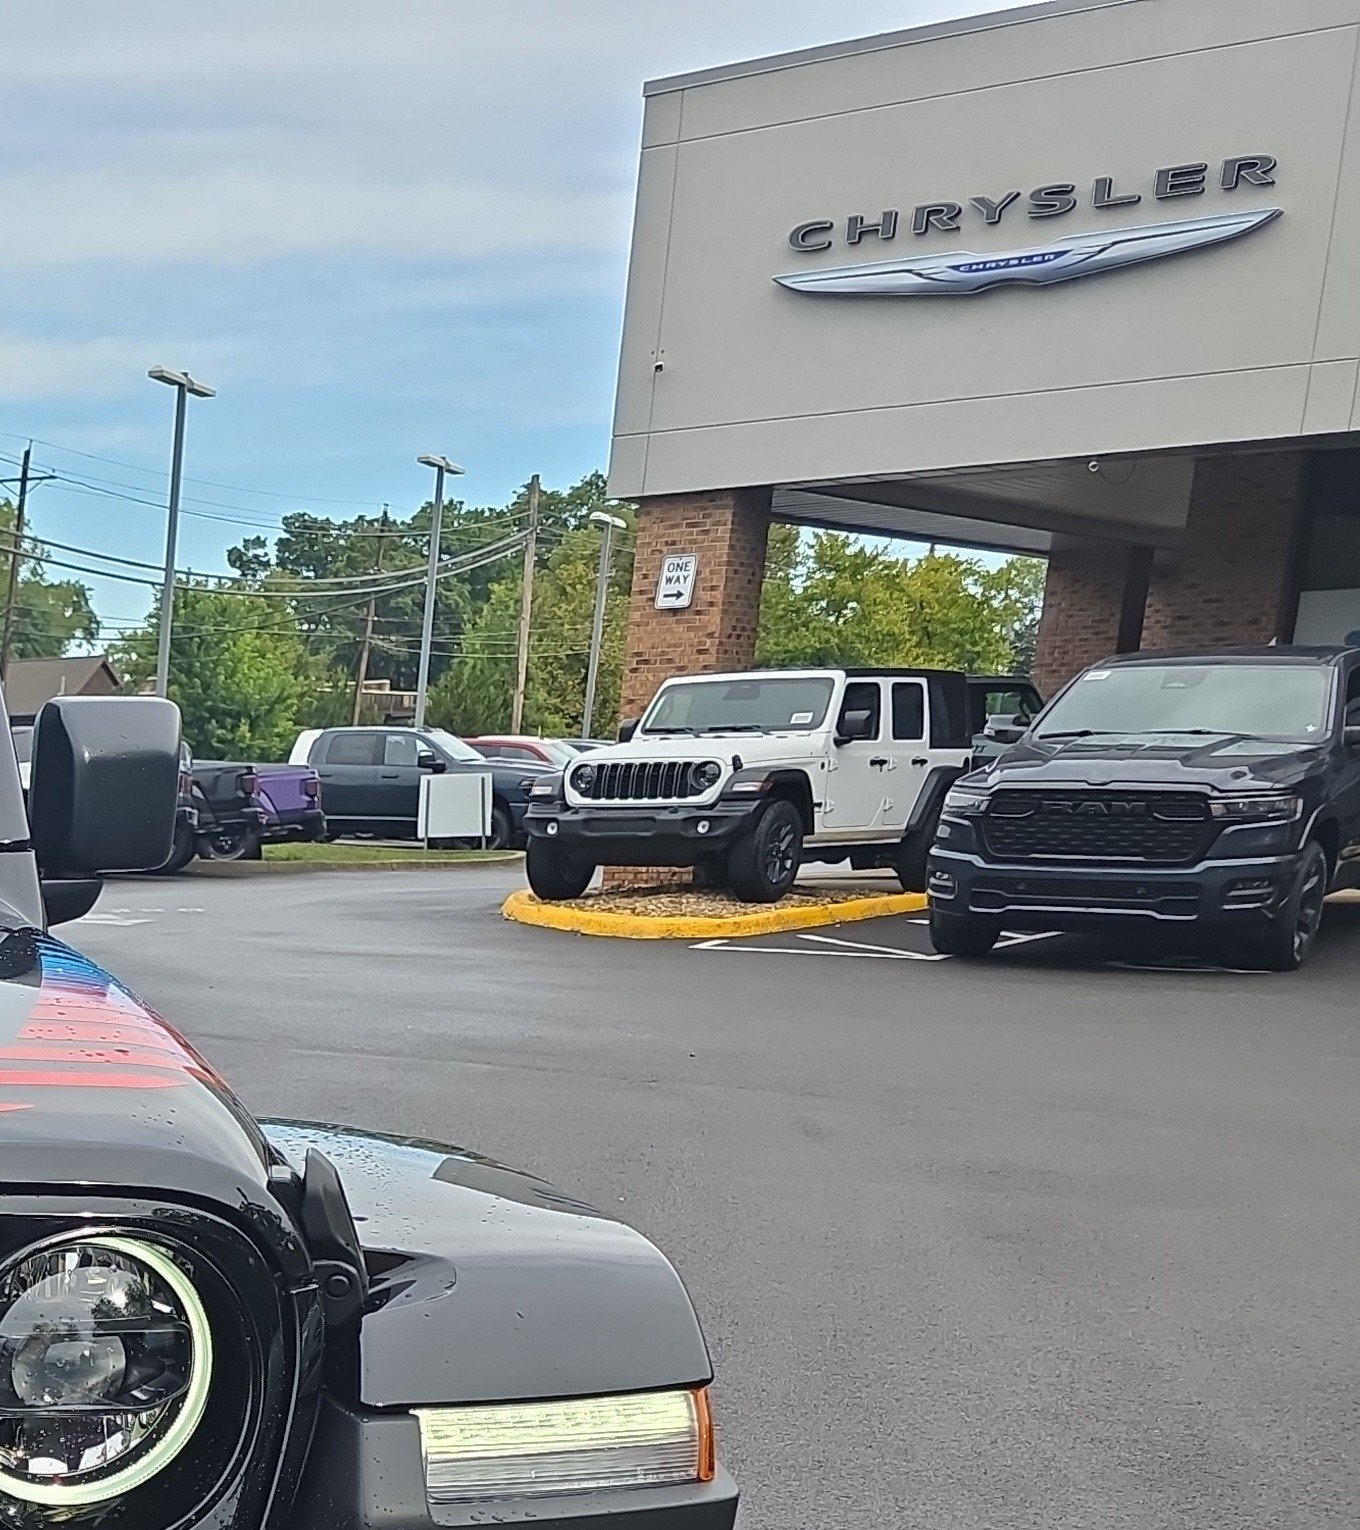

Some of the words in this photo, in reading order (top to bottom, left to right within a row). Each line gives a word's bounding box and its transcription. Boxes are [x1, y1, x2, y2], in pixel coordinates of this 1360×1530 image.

[788, 154, 1278, 251] CHRYSLER
[959, 254, 1056, 271] CHRYSLER
[667, 561, 691, 573] ONE
[665, 574, 690, 585] WAY
[1042, 801, 1146, 816] RAM
